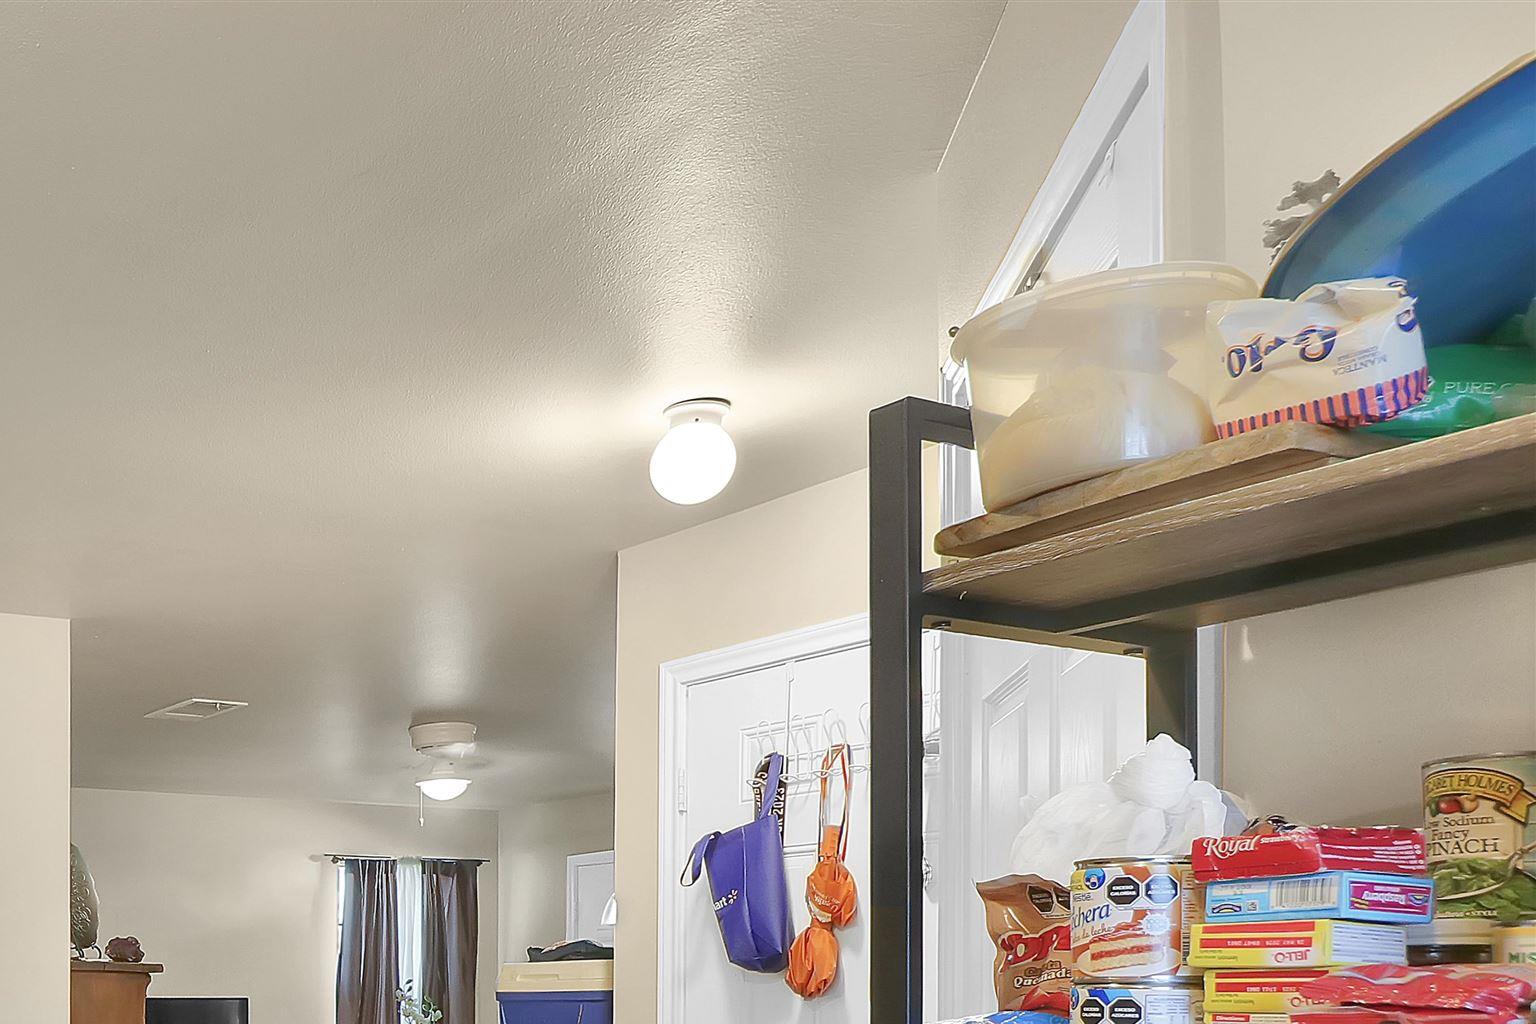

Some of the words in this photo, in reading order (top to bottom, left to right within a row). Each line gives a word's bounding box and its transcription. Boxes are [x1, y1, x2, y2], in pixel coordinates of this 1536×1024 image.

[1444, 381, 1496, 395] PURE
[1457, 774, 1516, 797] HOLMES
[1443, 815, 1497, 828] Sodium
[1431, 829, 1470, 842] Fancy
[1202, 835, 1258, 859] Royal
[1426, 838, 1500, 858] PINACH
